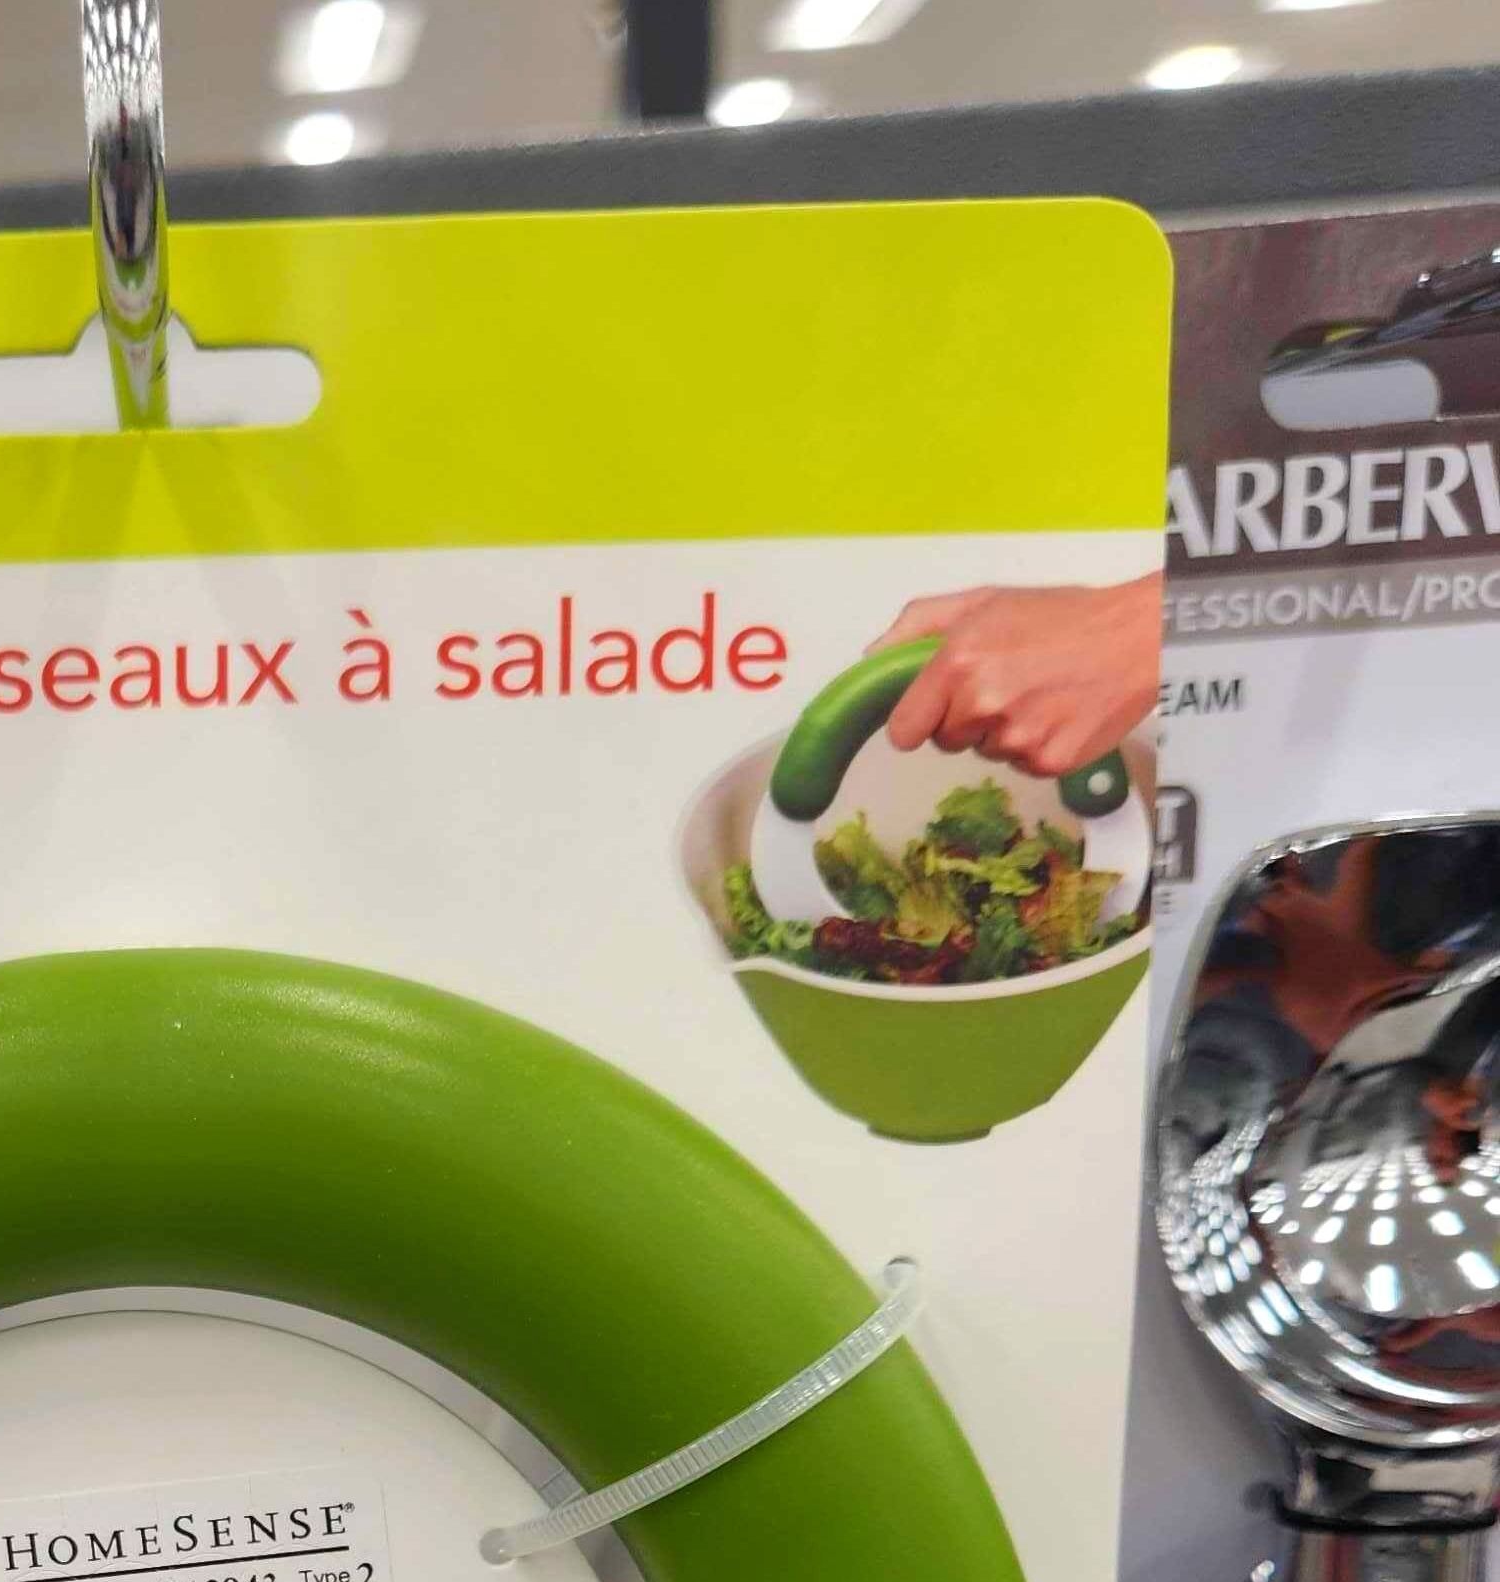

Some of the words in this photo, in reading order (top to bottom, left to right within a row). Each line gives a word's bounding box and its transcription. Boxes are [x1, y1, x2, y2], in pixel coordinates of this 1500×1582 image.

[1166, 441, 1500, 558] ARBER
[338, 608, 392, 703] à
[435, 592, 788, 701] salade
